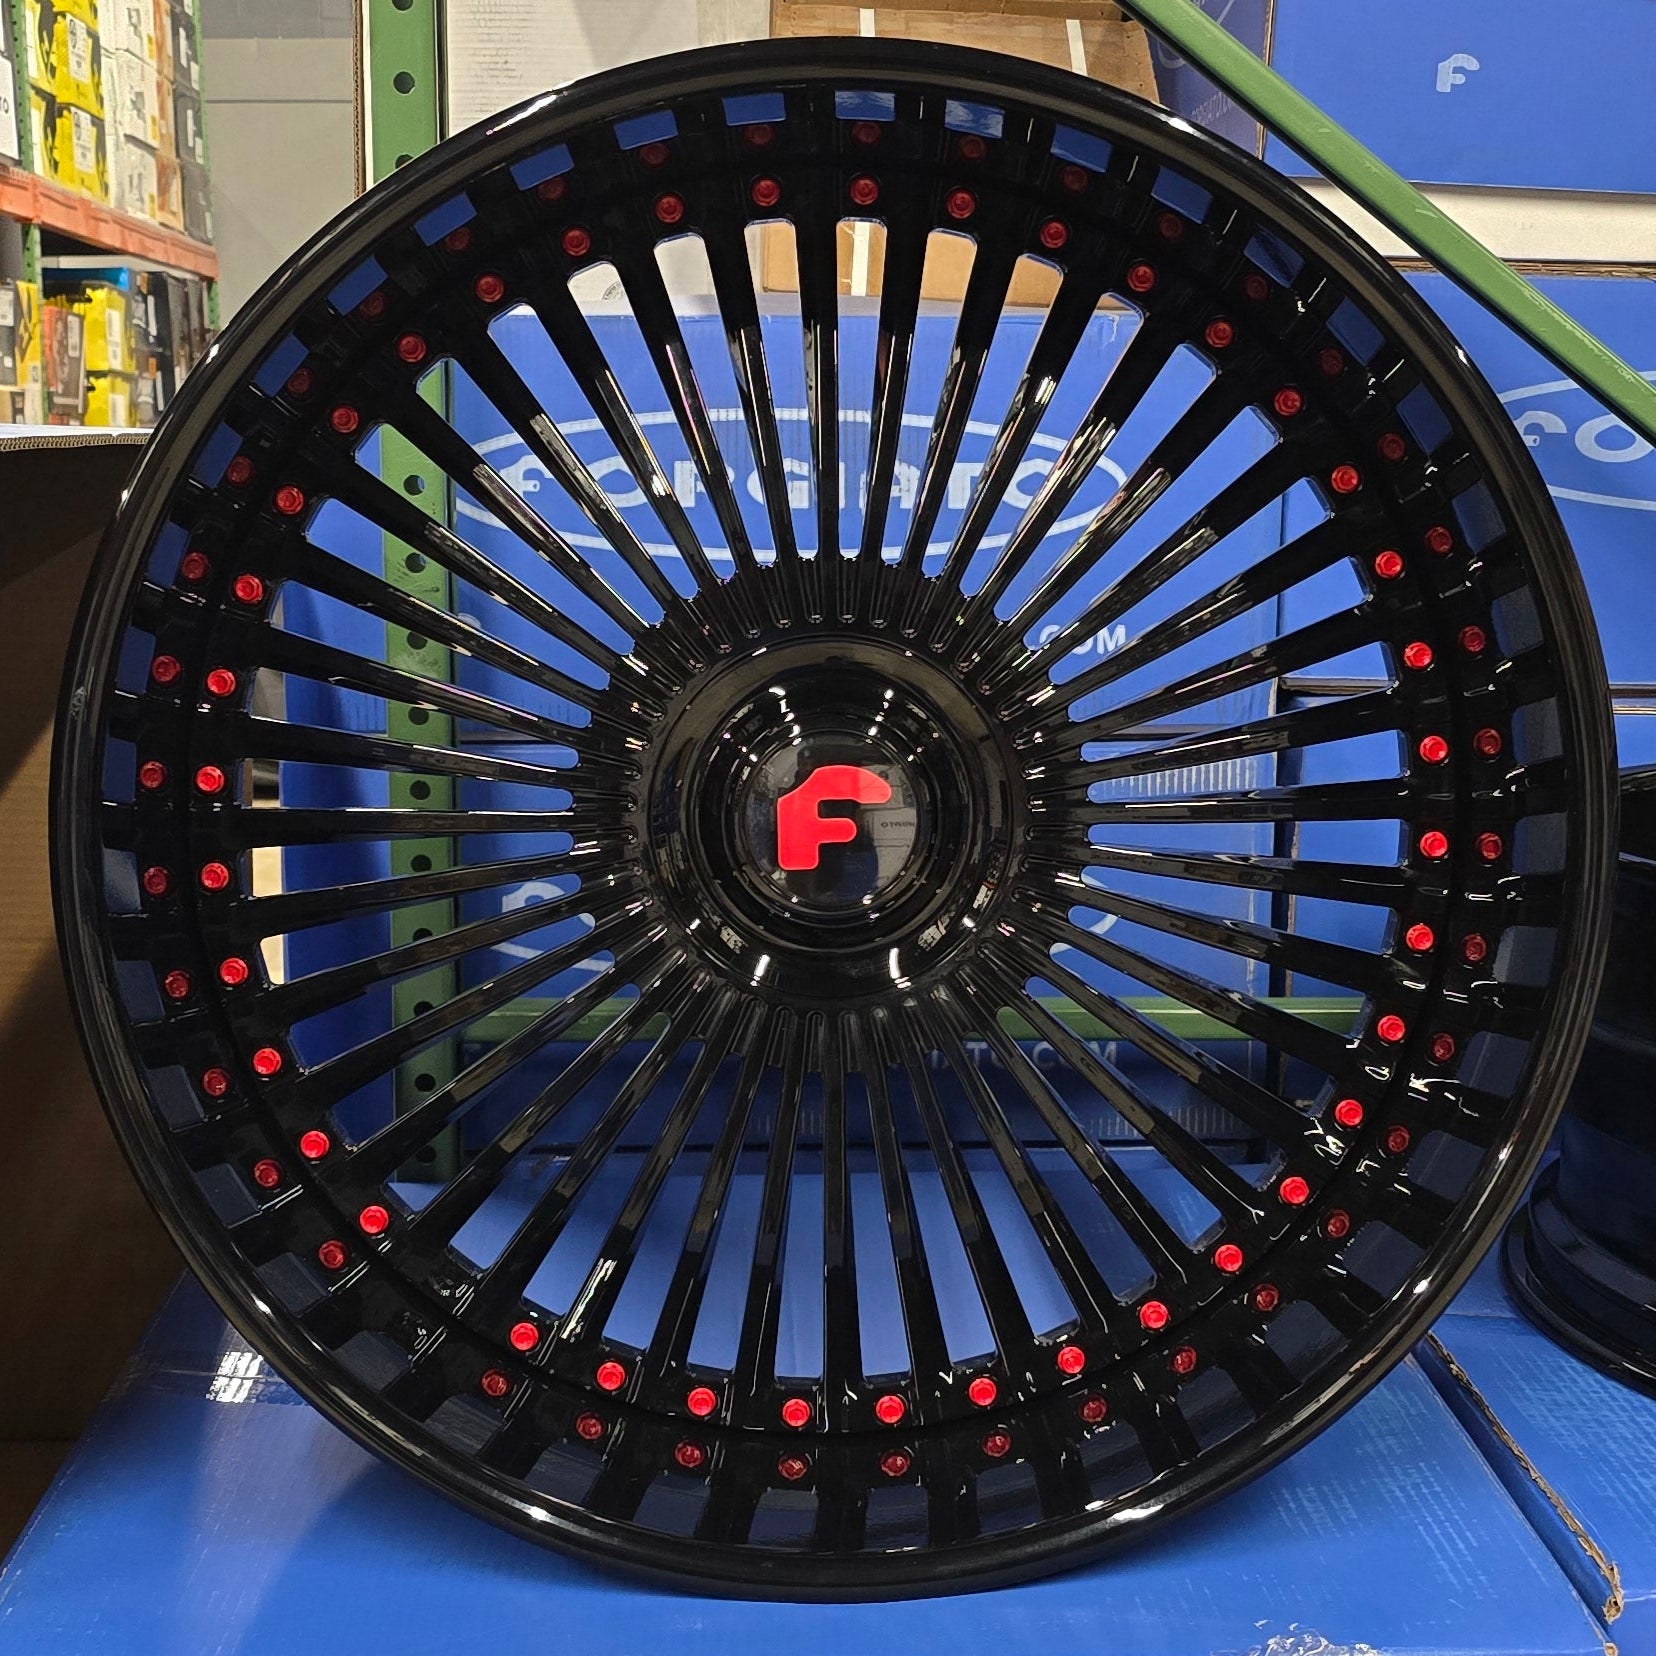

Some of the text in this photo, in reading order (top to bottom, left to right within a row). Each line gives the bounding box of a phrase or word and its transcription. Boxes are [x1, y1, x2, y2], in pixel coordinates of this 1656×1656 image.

[1436, 53, 1480, 93] F
[503, 453, 1060, 511] FORGATO
[778, 765, 892, 870] F
